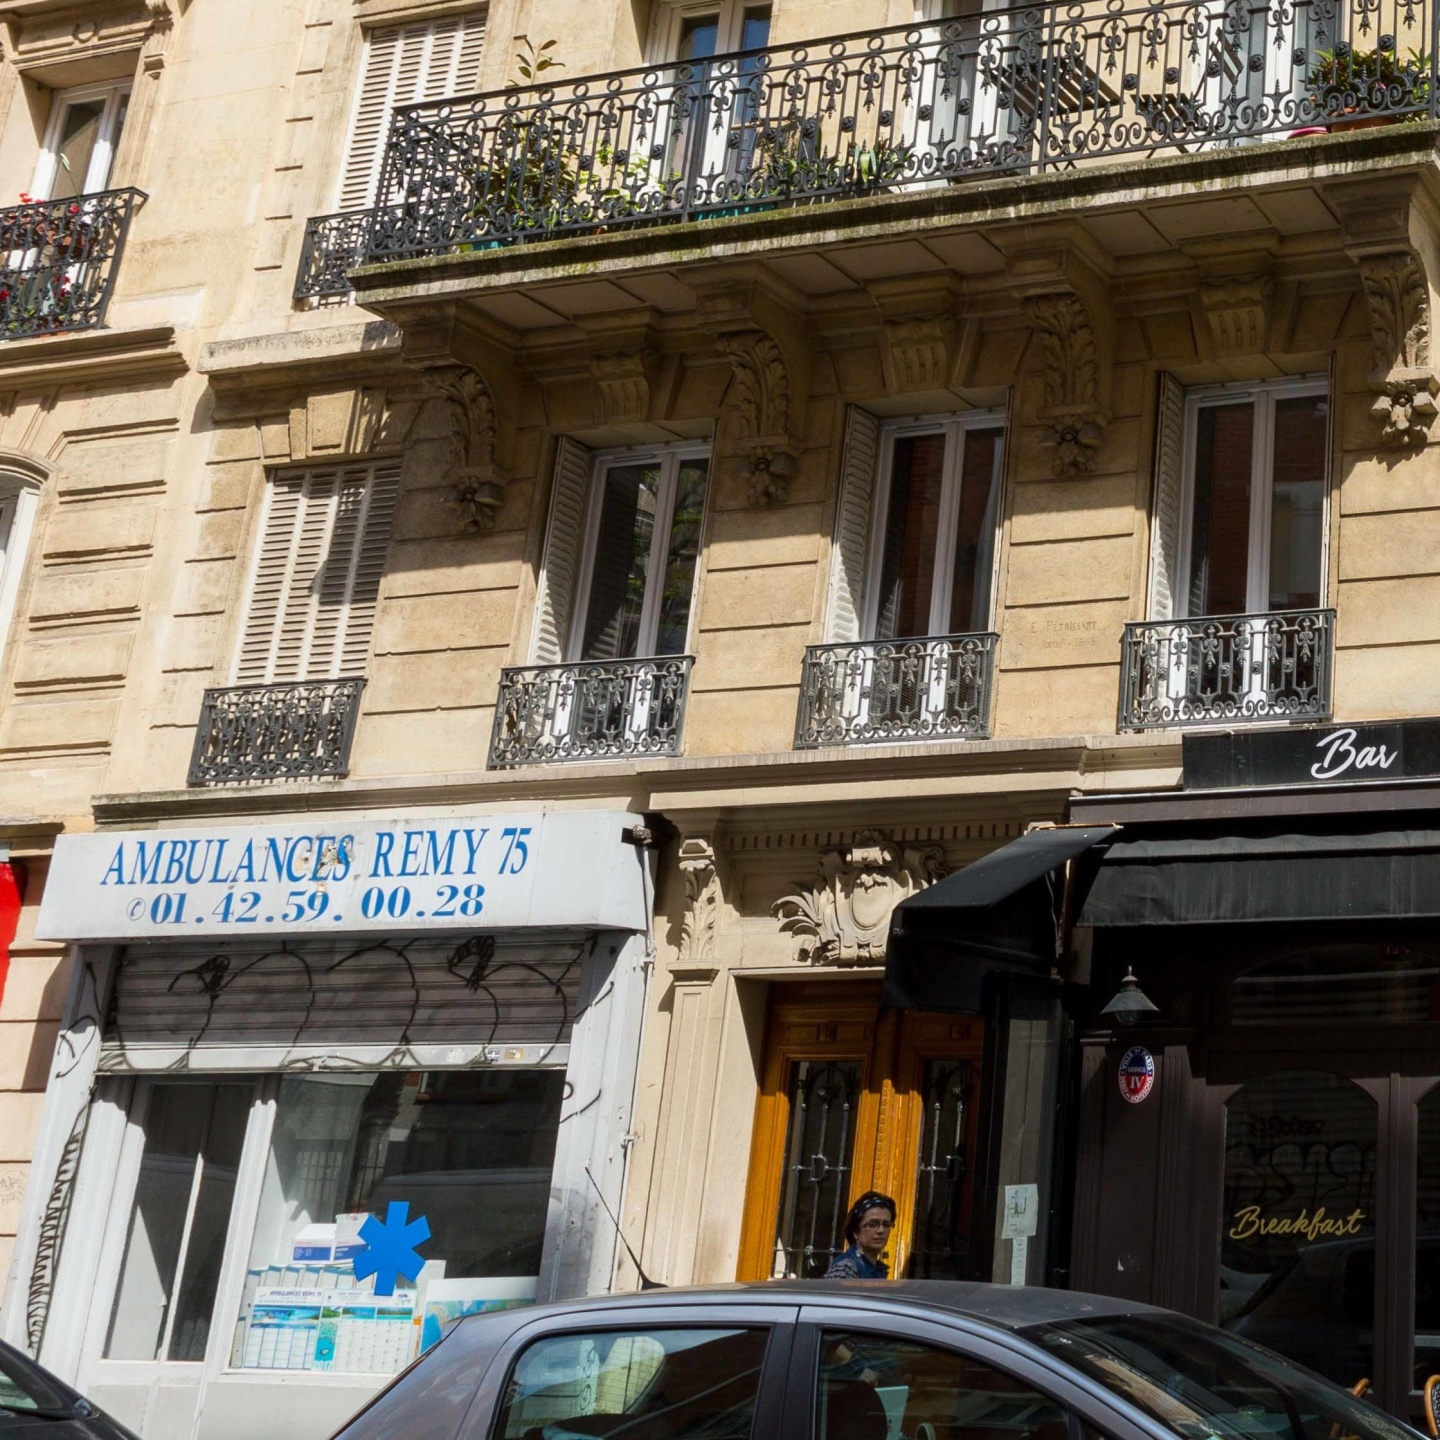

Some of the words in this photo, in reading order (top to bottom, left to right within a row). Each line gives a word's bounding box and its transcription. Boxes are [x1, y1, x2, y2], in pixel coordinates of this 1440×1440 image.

[1311, 728, 1398, 779] Bar
[99, 834, 356, 885] AMBULANCES
[368, 828, 489, 878] REMY
[497, 827, 532, 875] 75
[1130, 1075, 1145, 1089] IV
[1229, 1205, 1367, 1241] Breakfast
